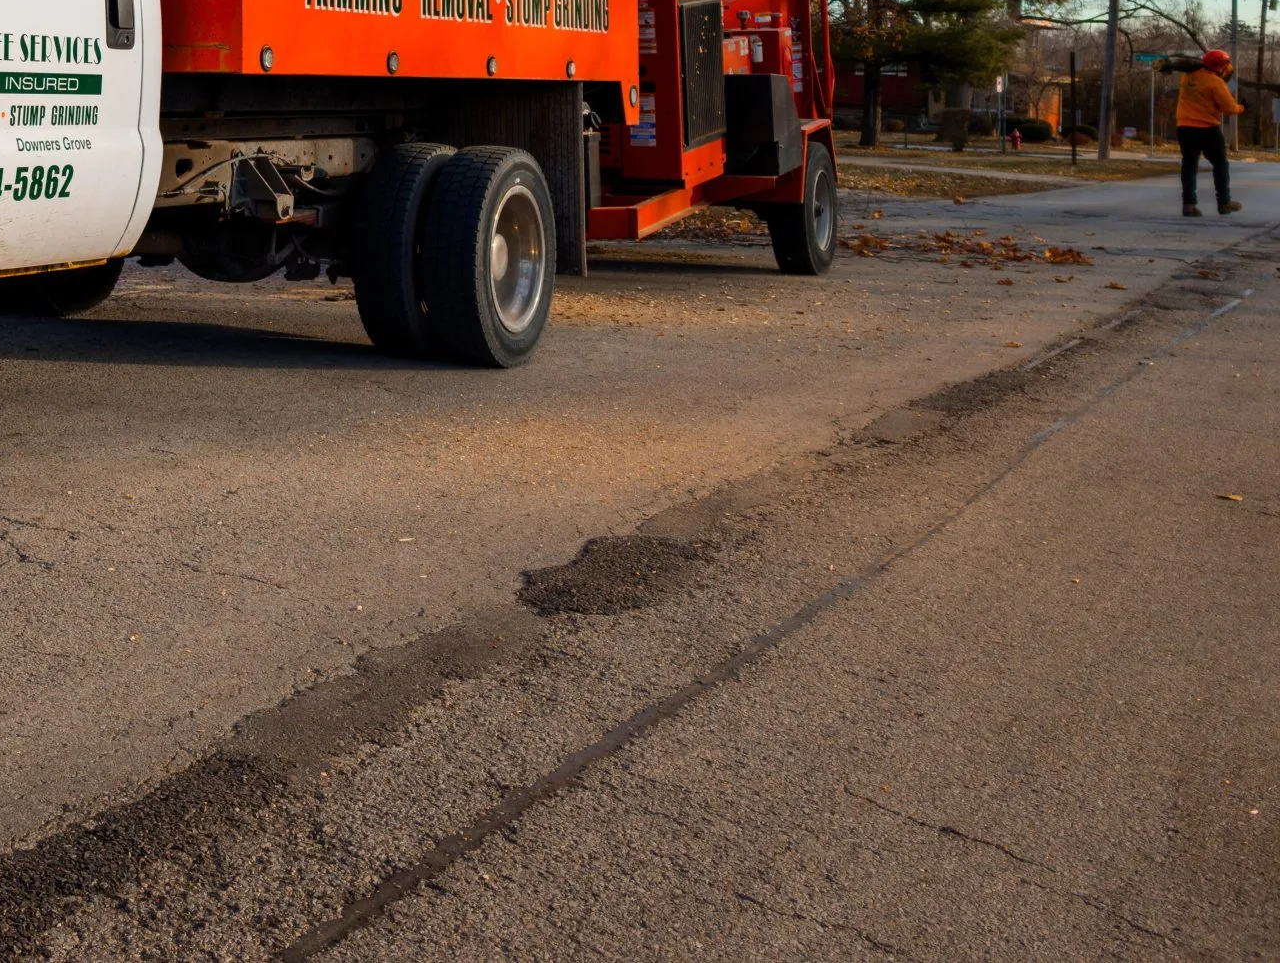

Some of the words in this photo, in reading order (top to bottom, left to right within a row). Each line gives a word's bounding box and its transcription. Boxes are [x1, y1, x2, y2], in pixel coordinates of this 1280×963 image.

[20, 33, 103, 65] SERVICES
[5, 76, 80, 92] INSURED
[9, 105, 46, 127] STUMP
[51, 105, 99, 126] GRINDING
[16, 137, 61, 153] Downers
[63, 137, 92, 152] Grove
